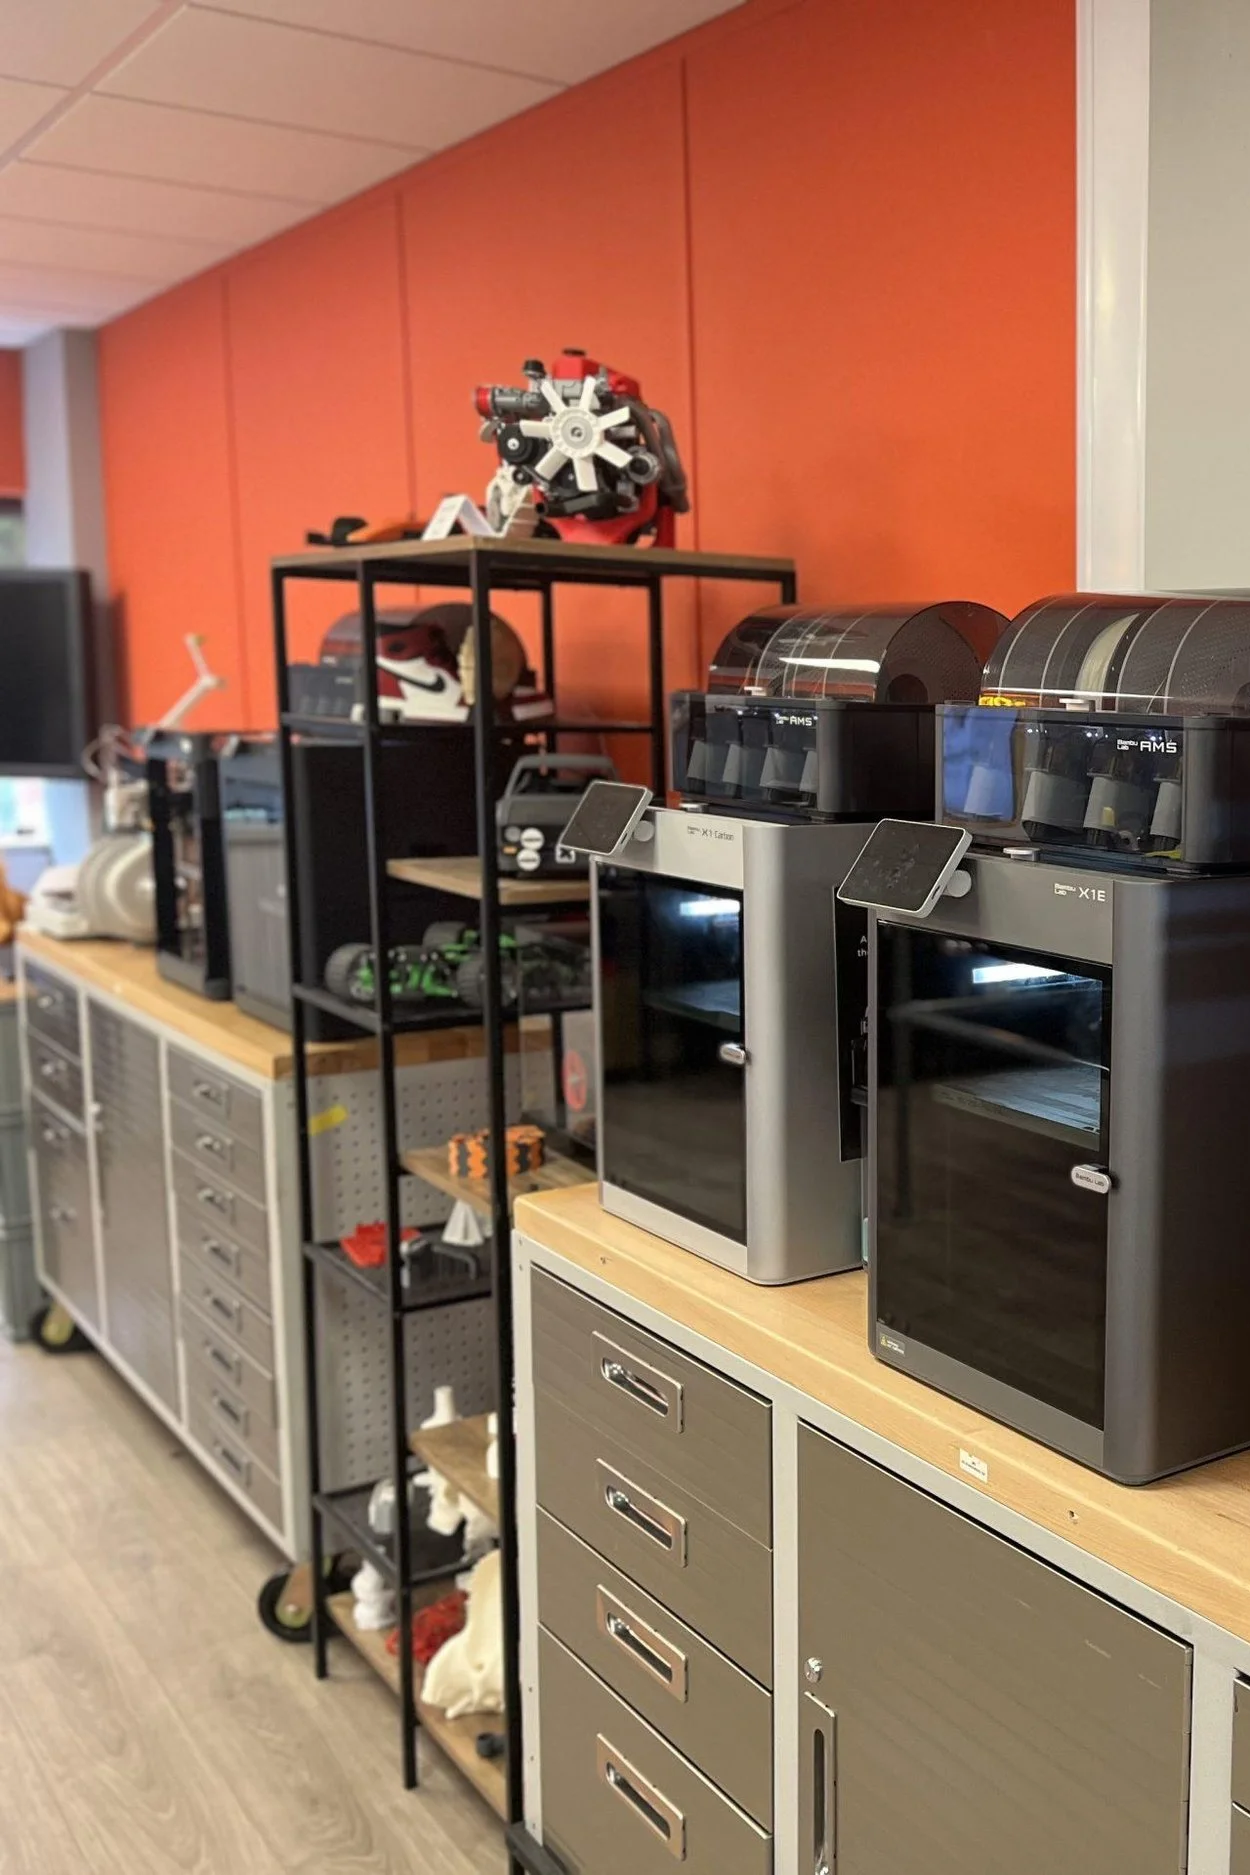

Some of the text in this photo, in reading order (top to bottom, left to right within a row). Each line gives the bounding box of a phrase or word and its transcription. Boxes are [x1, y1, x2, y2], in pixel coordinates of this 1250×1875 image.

[790, 715, 812, 726] AMS
[1140, 740, 1177, 753] AMS
[1078, 886, 1106, 902] X1E
